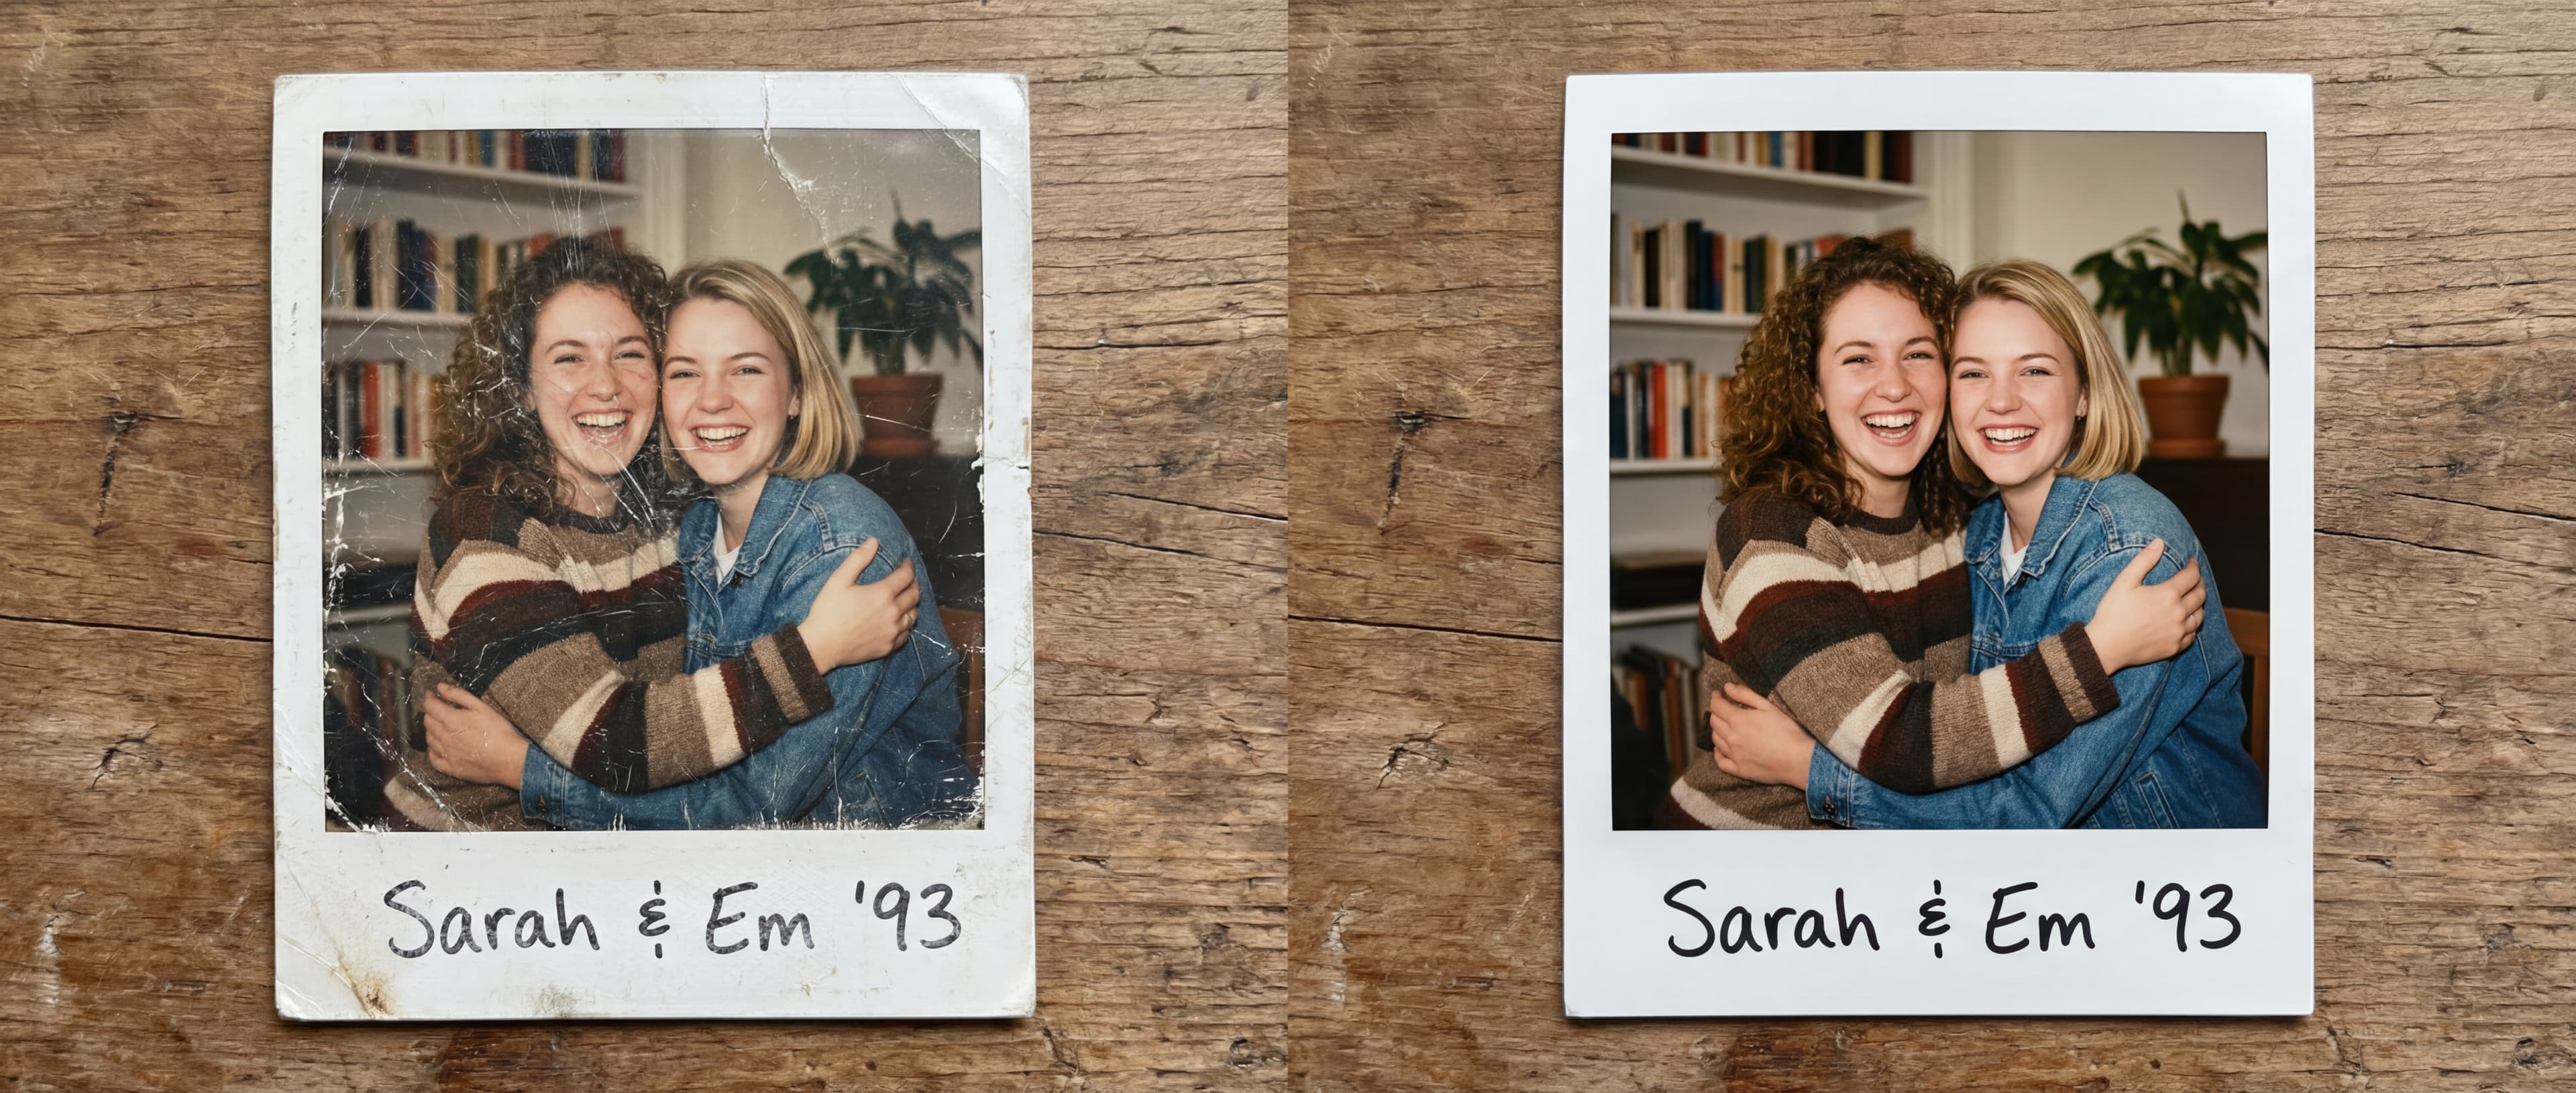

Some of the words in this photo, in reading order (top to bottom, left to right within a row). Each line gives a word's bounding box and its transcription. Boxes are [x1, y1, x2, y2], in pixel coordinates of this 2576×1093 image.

[383, 879, 601, 959] Sarah
[638, 880, 672, 959] &
[705, 882, 816, 956] Em
[855, 880, 963, 952] '93
[1663, 878, 1880, 958] Sarah
[1918, 878, 1951, 959] &
[1985, 882, 2096, 955] Em
[2135, 880, 2242, 953] '93
